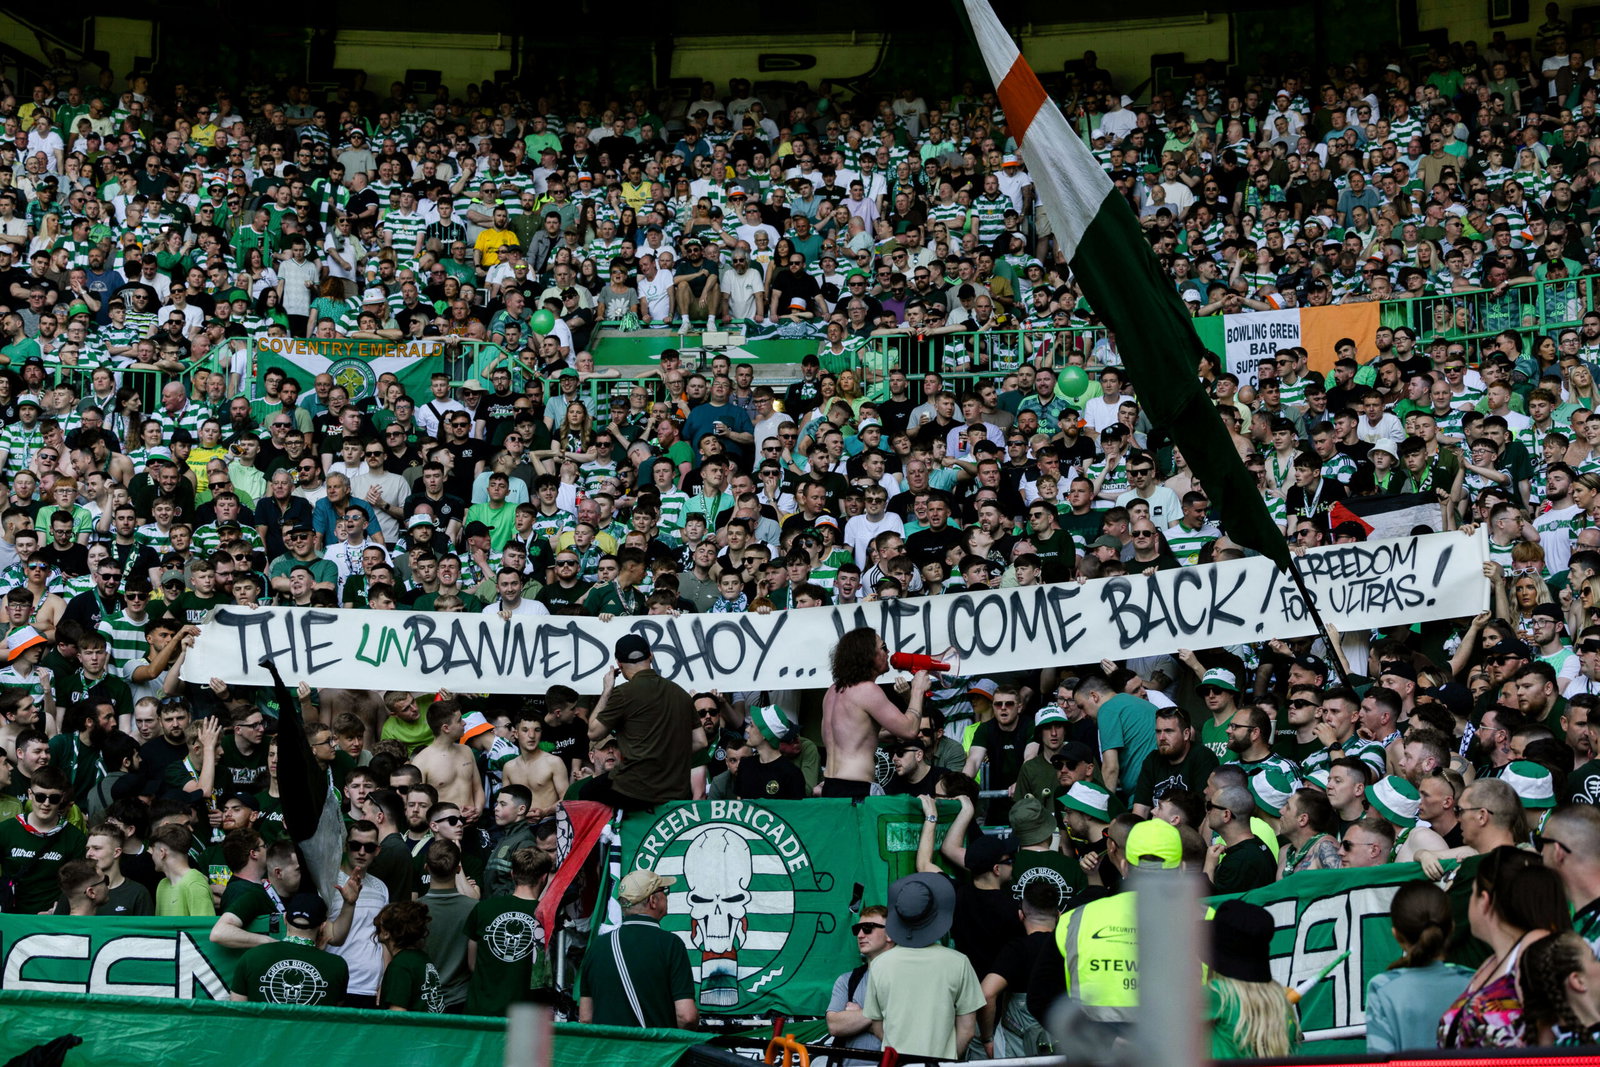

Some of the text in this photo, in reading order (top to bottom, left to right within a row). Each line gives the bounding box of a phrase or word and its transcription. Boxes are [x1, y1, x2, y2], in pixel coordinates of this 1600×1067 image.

[1227, 322, 1299, 343] BOWLING GREEN
[258, 337, 443, 357] COVENTRY EMERALD
[1250, 342, 1277, 355] BAR
[1288, 537, 1418, 583] FREEDOM
[1280, 586, 1321, 622] FOR
[215, 607, 342, 676] THE
[355, 615, 610, 681] UNBANNED
[1100, 563, 1280, 650] BACK!
[635, 800, 809, 873] GREEN BRIGADE
[39, 851, 62, 861] eltic
[1019, 868, 1066, 888] GREEN BRIGADE
[493, 913, 513, 928] GREEN
[267, 960, 321, 982] GREEN BRIGADE
[1090, 959, 1140, 972] STEW
